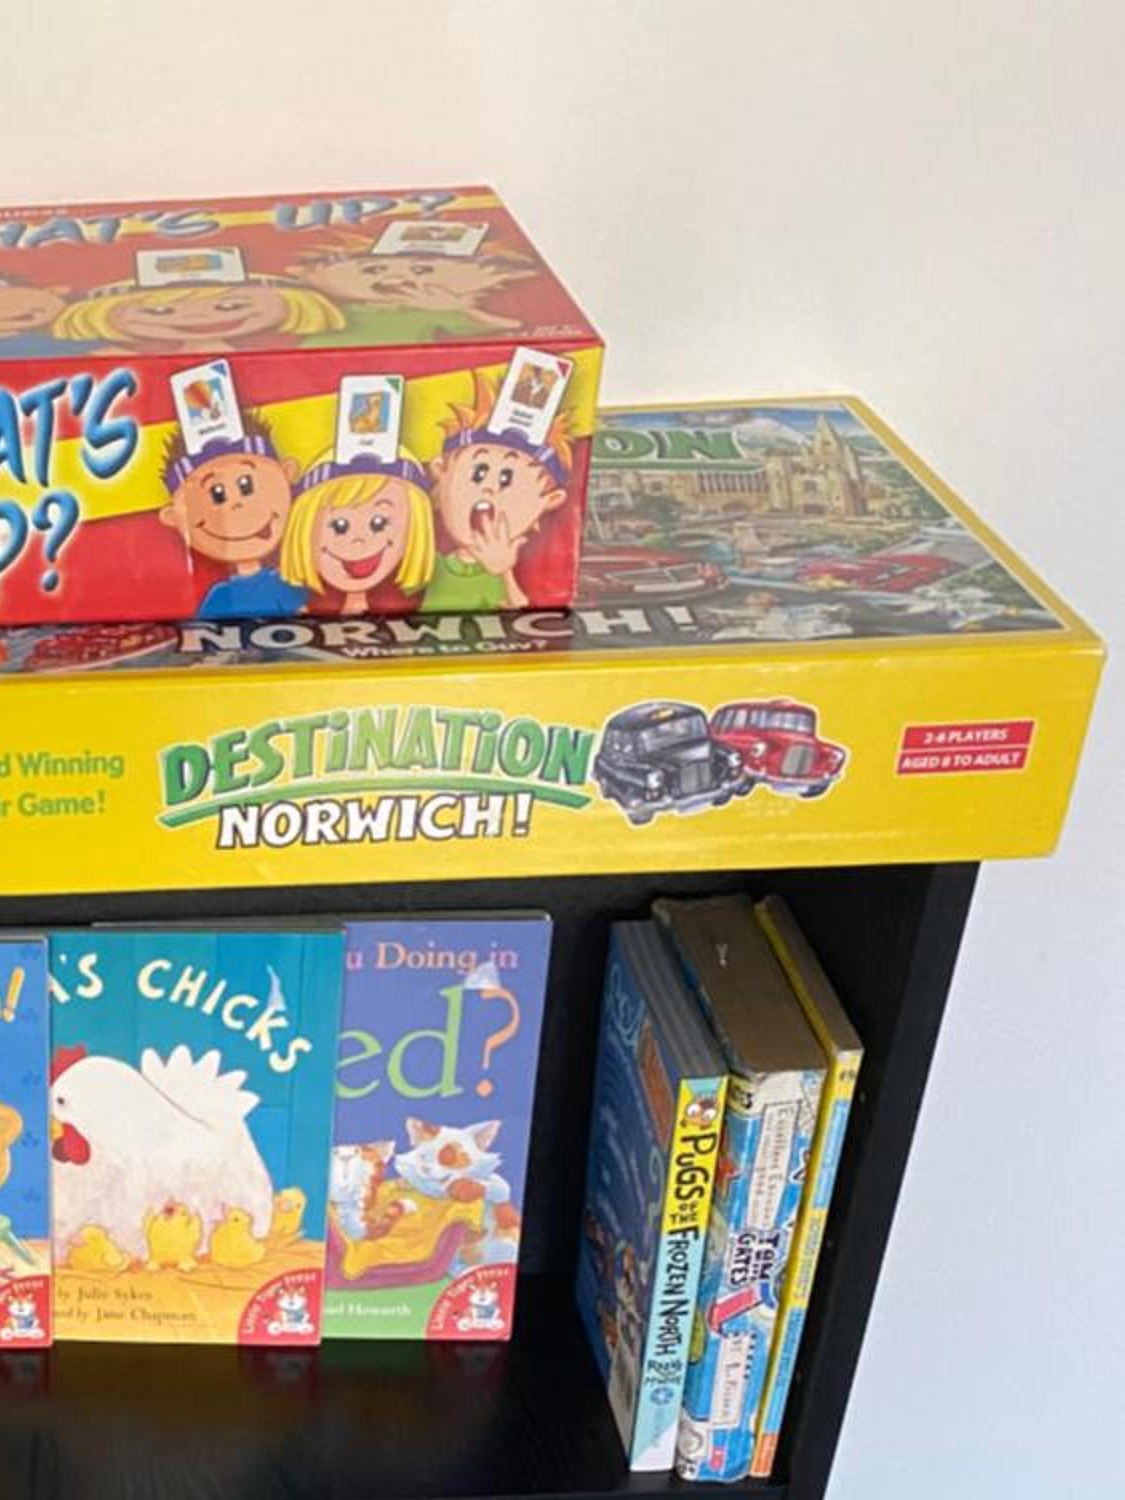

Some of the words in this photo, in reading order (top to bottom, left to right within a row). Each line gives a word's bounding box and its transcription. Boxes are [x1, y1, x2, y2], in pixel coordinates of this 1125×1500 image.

[272, 193, 456, 231] UP?
[179, 605, 700, 653] NORWICH!
[343, 643, 427, 659] Where
[434, 642, 469, 656] to
[948, 728, 1008, 744] PLAYERS
[18, 750, 125, 785] Winning
[160, 706, 597, 808] DESTINATION
[901, 756, 940, 769] AGED
[954, 754, 973, 767] TO
[973, 751, 1021, 766] ADULT
[17, 789, 106, 819] Game!
[216, 790, 535, 850] NORWICH!
[376, 942, 480, 981] Doing
[490, 941, 519, 969] in
[137, 959, 313, 1074] CHICKS
[661, 1225, 700, 1296] FROZEN
[730, 1232, 757, 1286] GATES
[77, 1285, 107, 1303] Julie
[345, 1302, 412, 1316] Howarth
[129, 1307, 198, 1326] Chapman
[654, 1299, 691, 1357] NORTH
